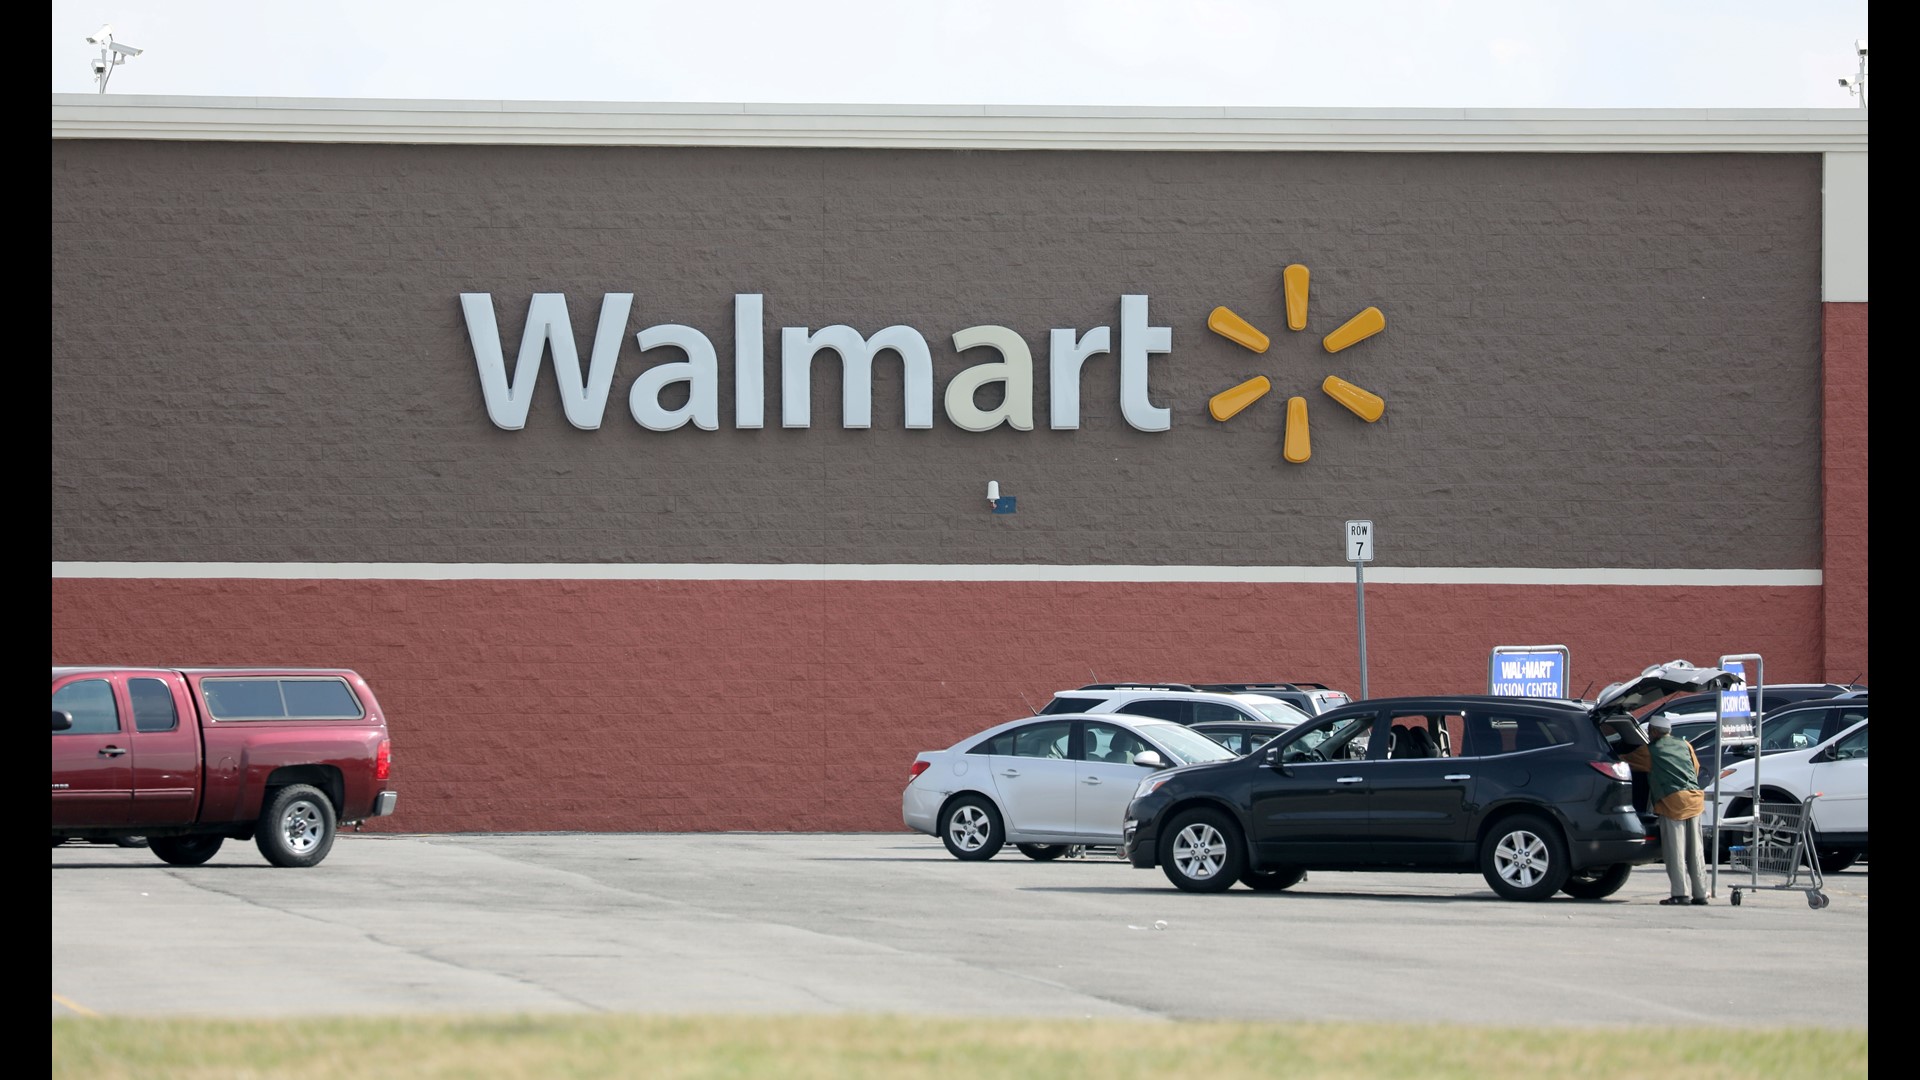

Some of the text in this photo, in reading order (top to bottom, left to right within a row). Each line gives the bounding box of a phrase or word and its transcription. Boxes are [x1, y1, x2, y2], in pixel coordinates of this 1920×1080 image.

[460, 292, 1173, 432] Walmart
[1351, 525, 1368, 536] ROW
[1355, 541, 1364, 556] 7
[1493, 682, 1558, 697] VISION CENTER
